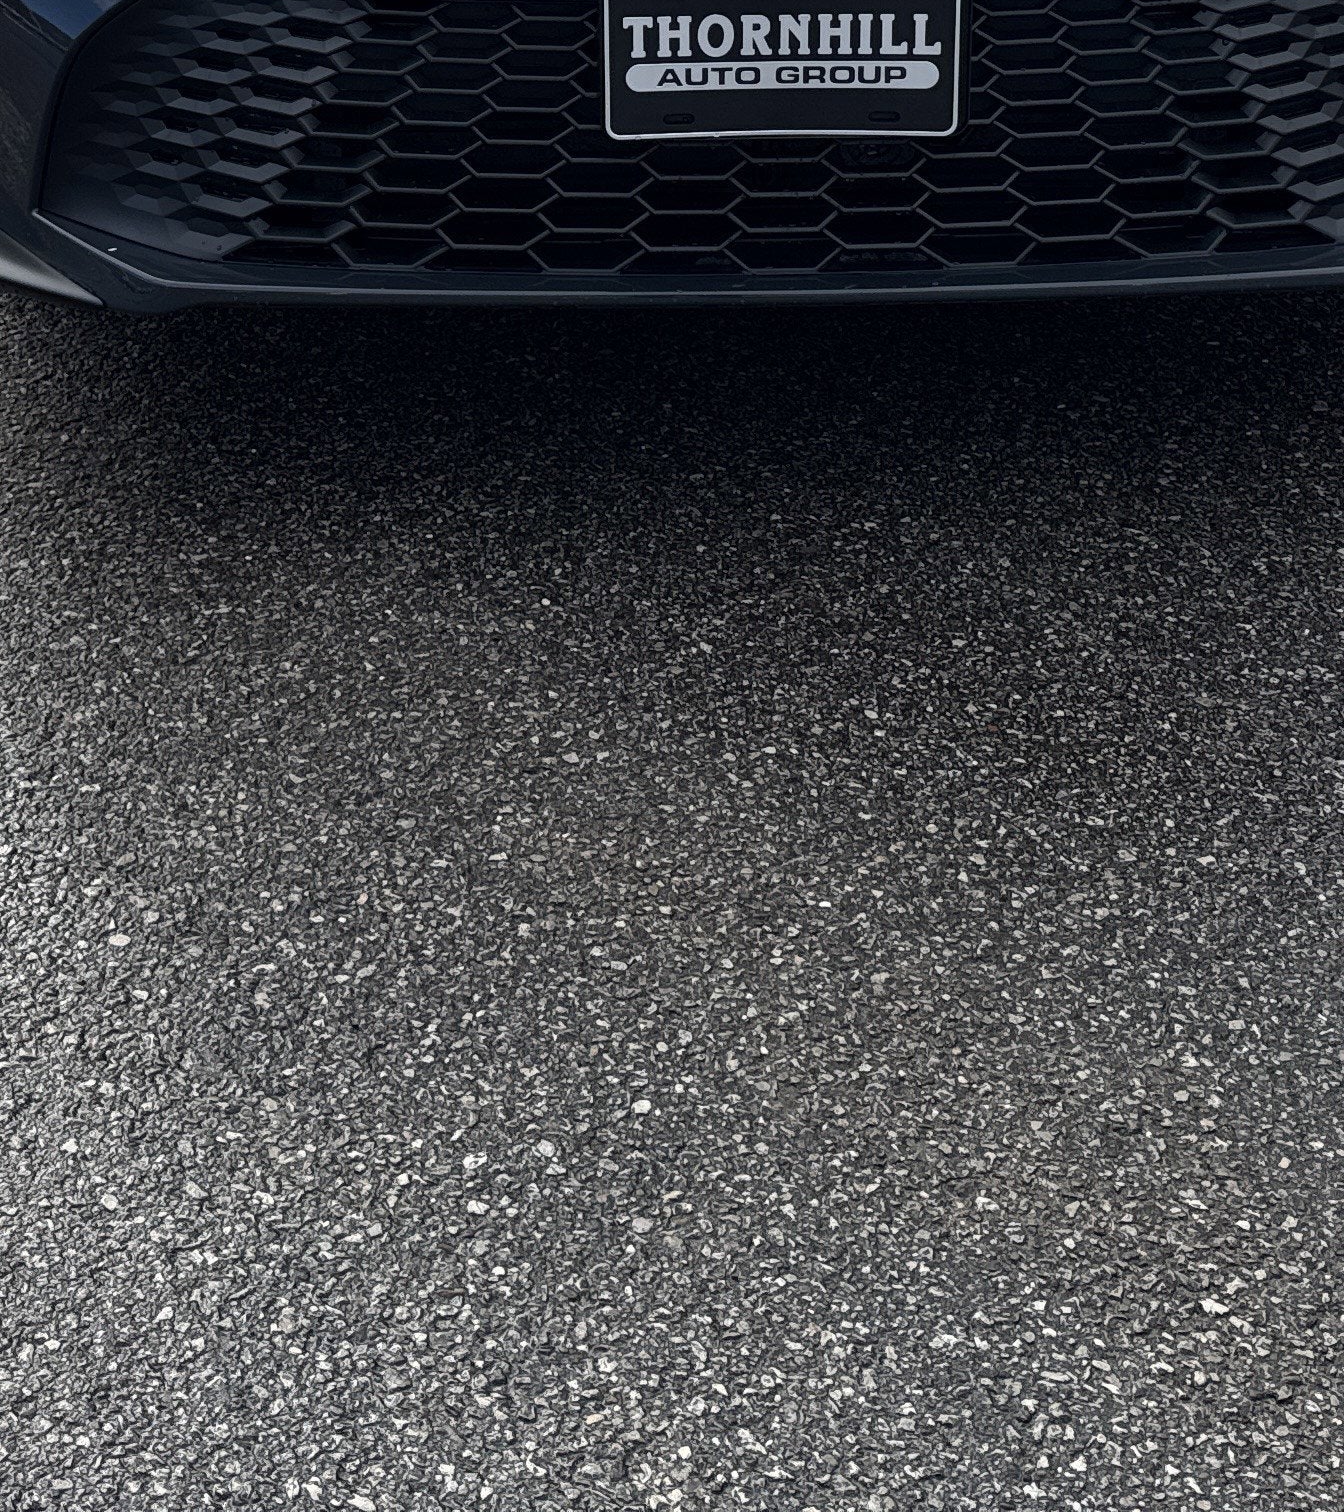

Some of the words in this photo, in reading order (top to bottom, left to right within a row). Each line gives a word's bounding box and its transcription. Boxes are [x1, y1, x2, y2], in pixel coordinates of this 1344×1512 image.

[622, 13, 942, 58] THORNHILL
[657, 67, 761, 87] AUTO
[775, 66, 907, 85] GROUP
